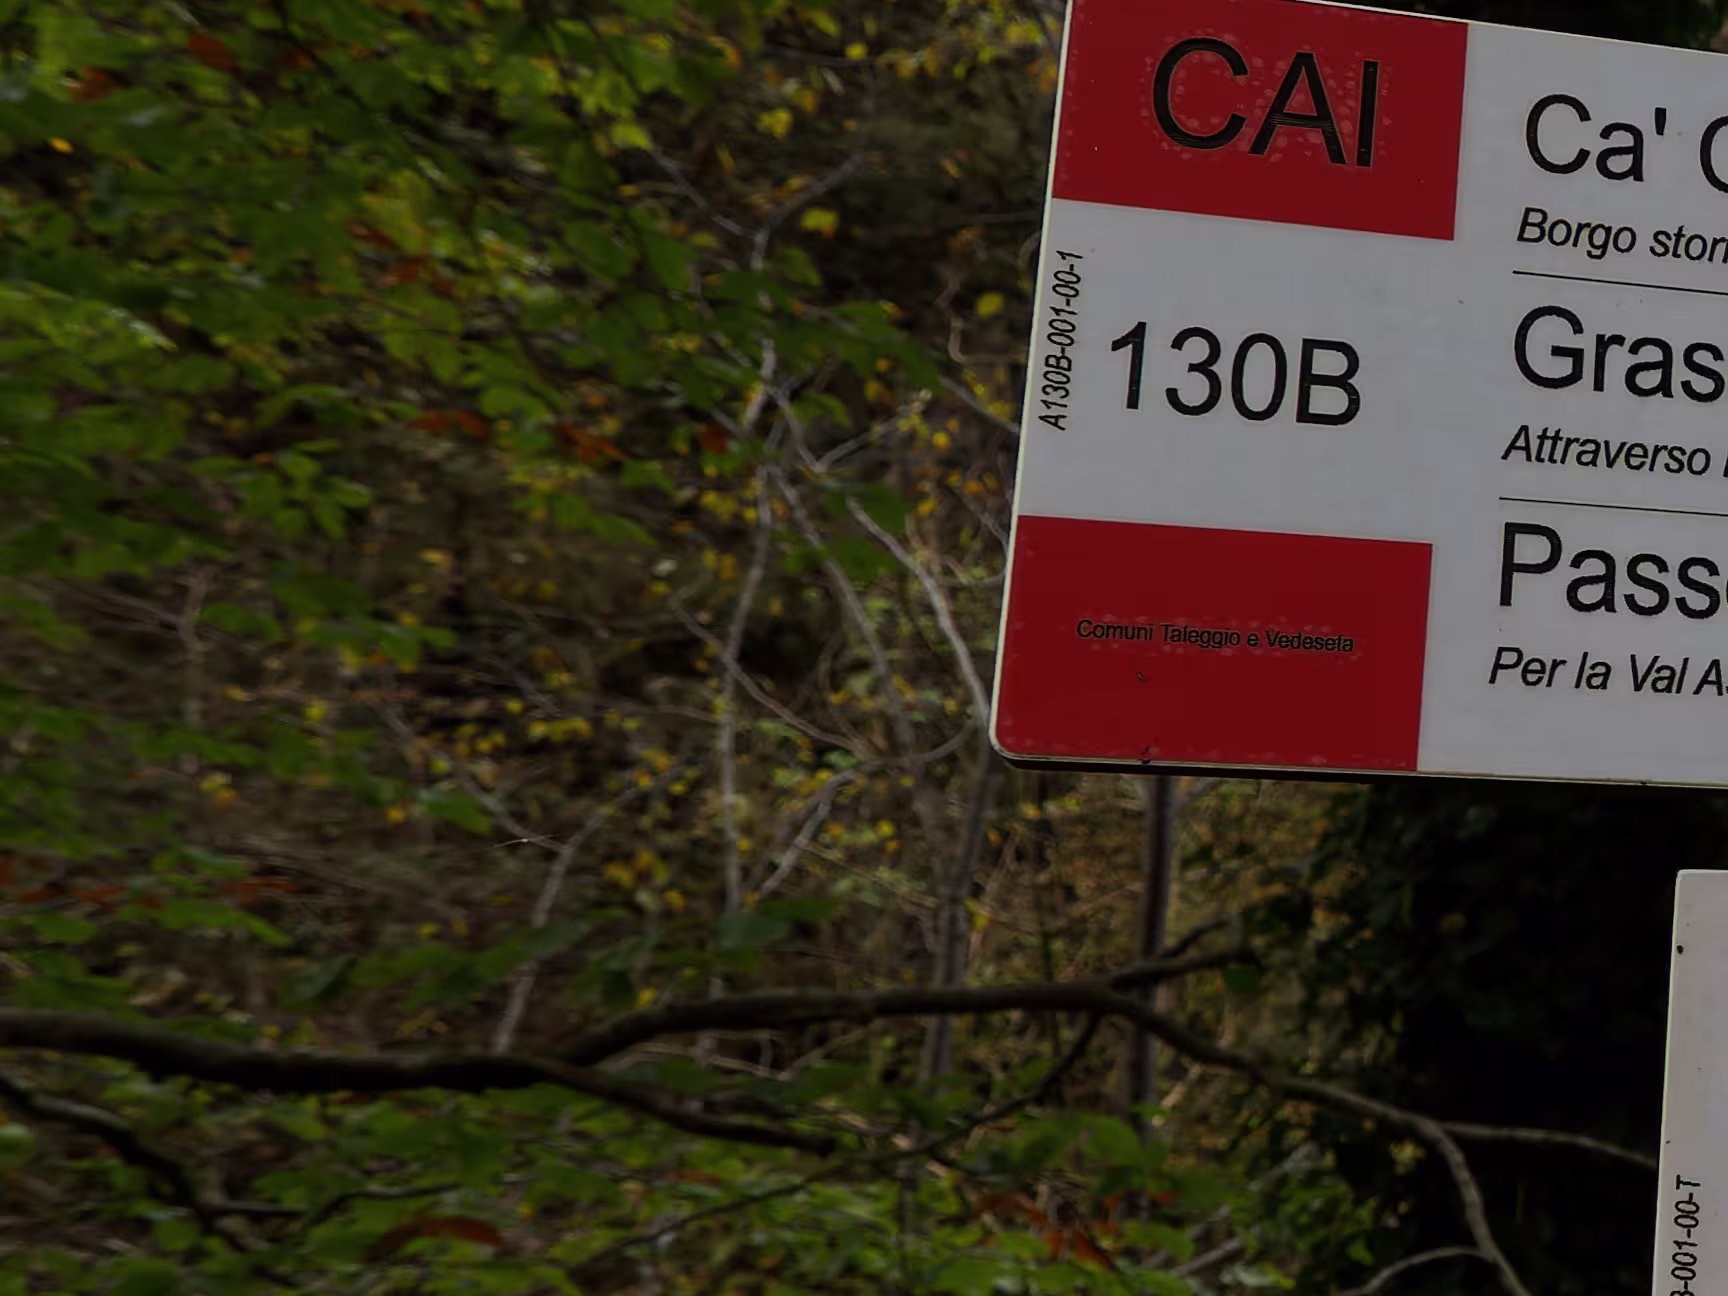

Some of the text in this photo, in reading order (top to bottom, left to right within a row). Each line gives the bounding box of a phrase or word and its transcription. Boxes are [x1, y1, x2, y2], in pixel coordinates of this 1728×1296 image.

[1153, 37, 1378, 168] CAI
[1525, 93, 1667, 182] Ca'
[1517, 207, 1637, 260] Borgo
[1038, 250, 1083, 431] A130B-001-00-1
[1109, 321, 1360, 426] 130B
[1501, 424, 1711, 475] Attraverso
[1077, 619, 1354, 652] Comuni Taleggio e Vedeseta
[1487, 646, 1567, 689] Per
[1575, 651, 1612, 692] la
[1628, 655, 1685, 695] Val
